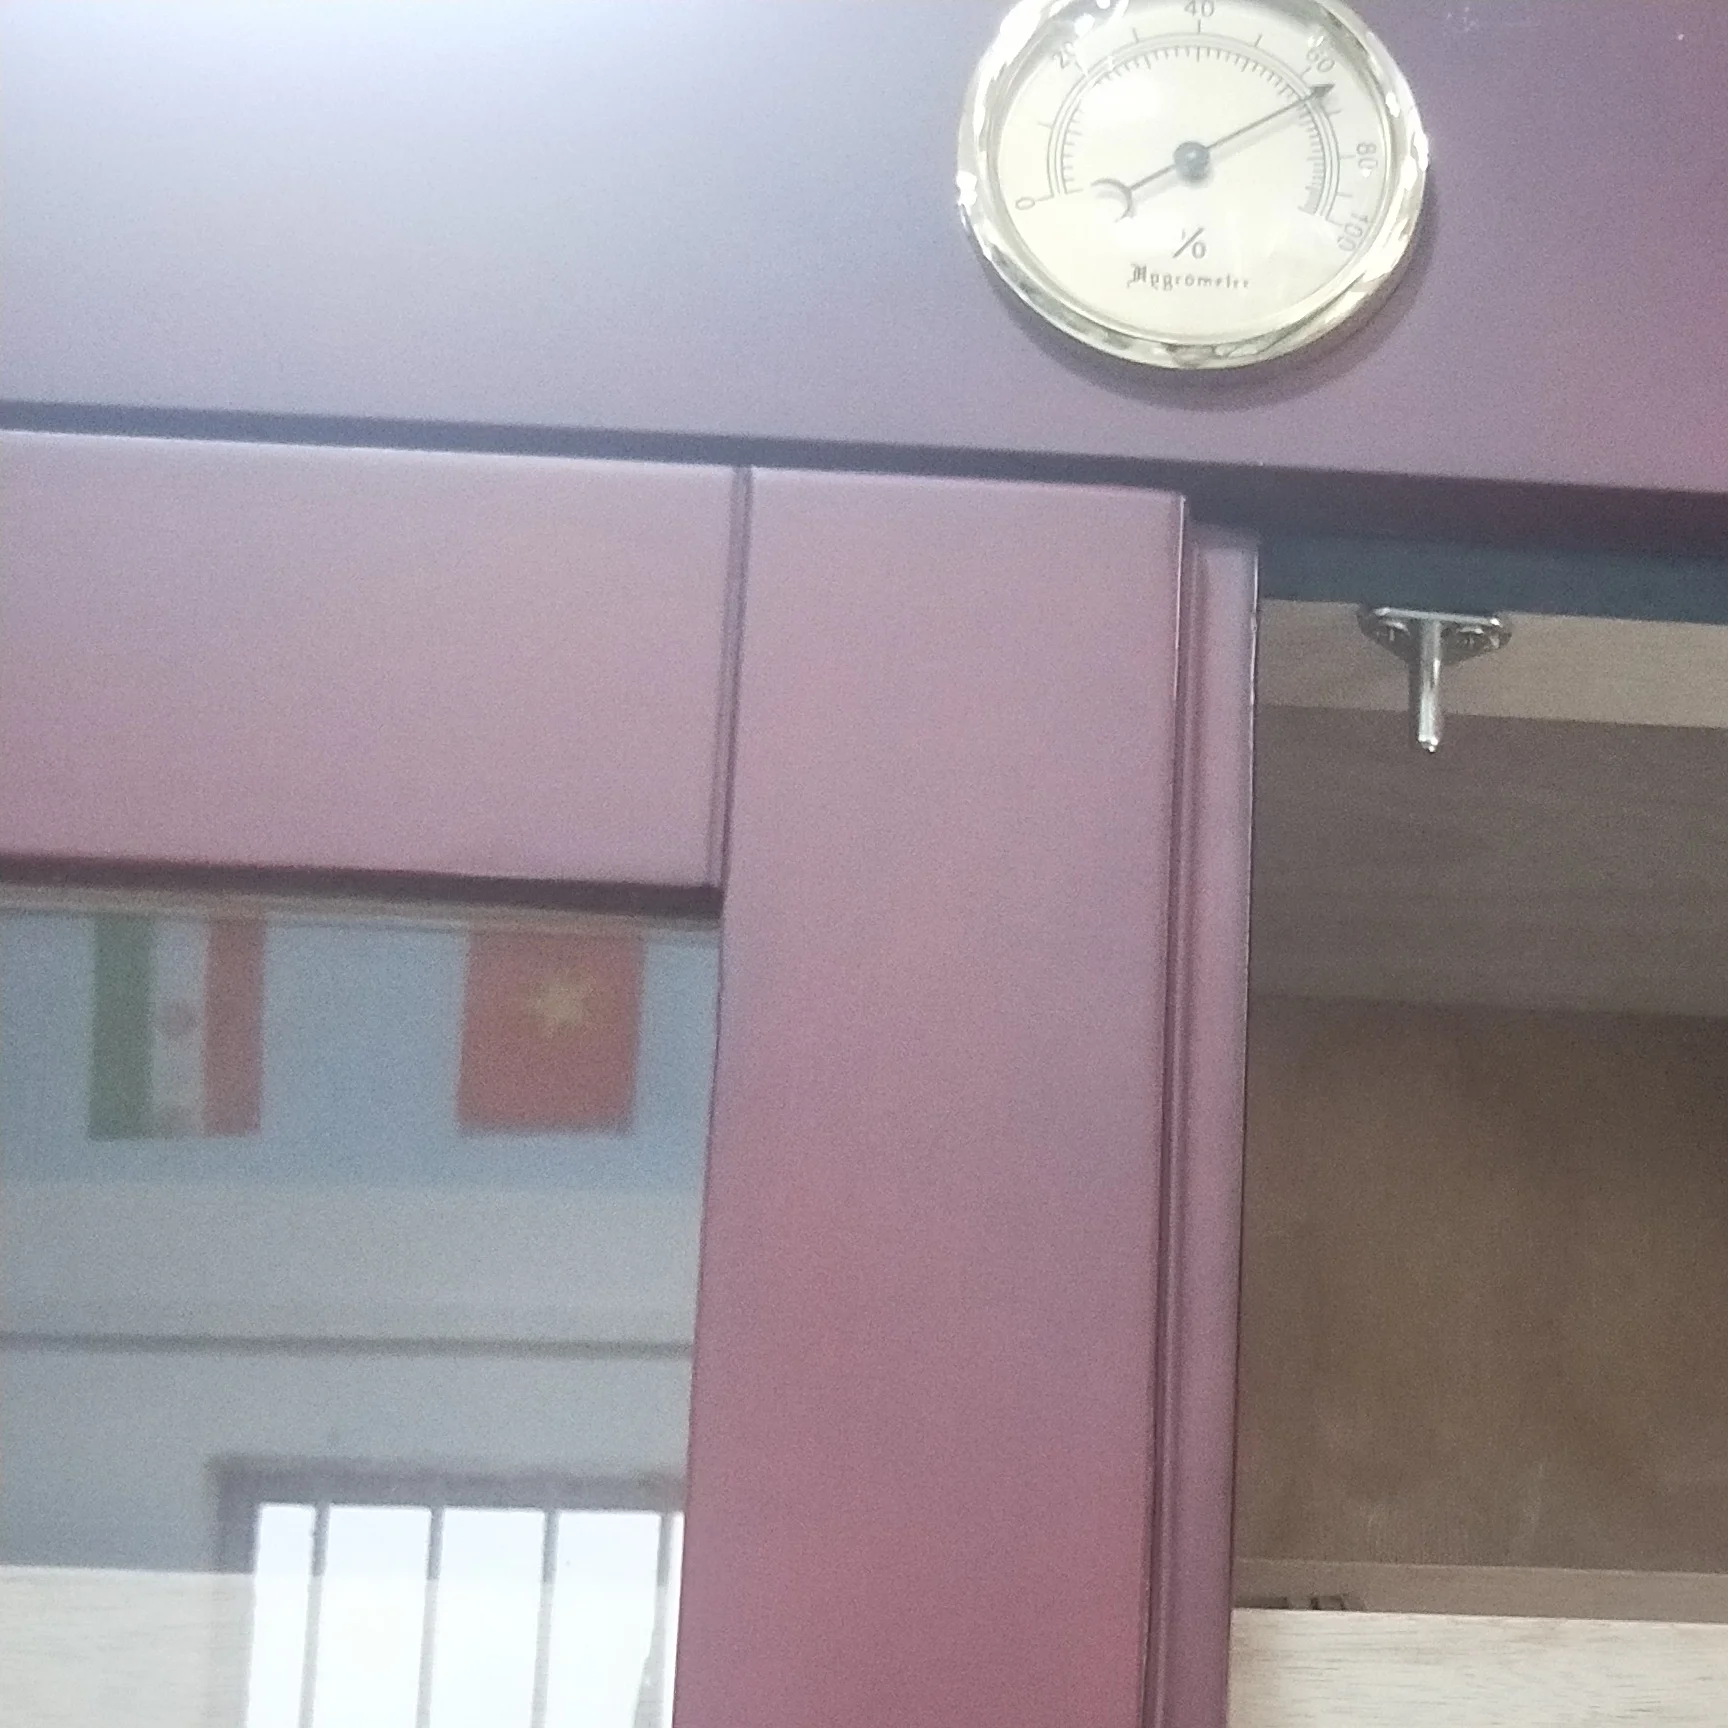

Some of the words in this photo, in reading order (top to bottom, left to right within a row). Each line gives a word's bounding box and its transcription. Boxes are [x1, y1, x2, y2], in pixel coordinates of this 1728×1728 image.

[1184, 0, 1215, 18] 40
[1355, 141, 1379, 173] 80
[1014, 195, 1036, 211] 0
[1336, 212, 1369, 252] 100
